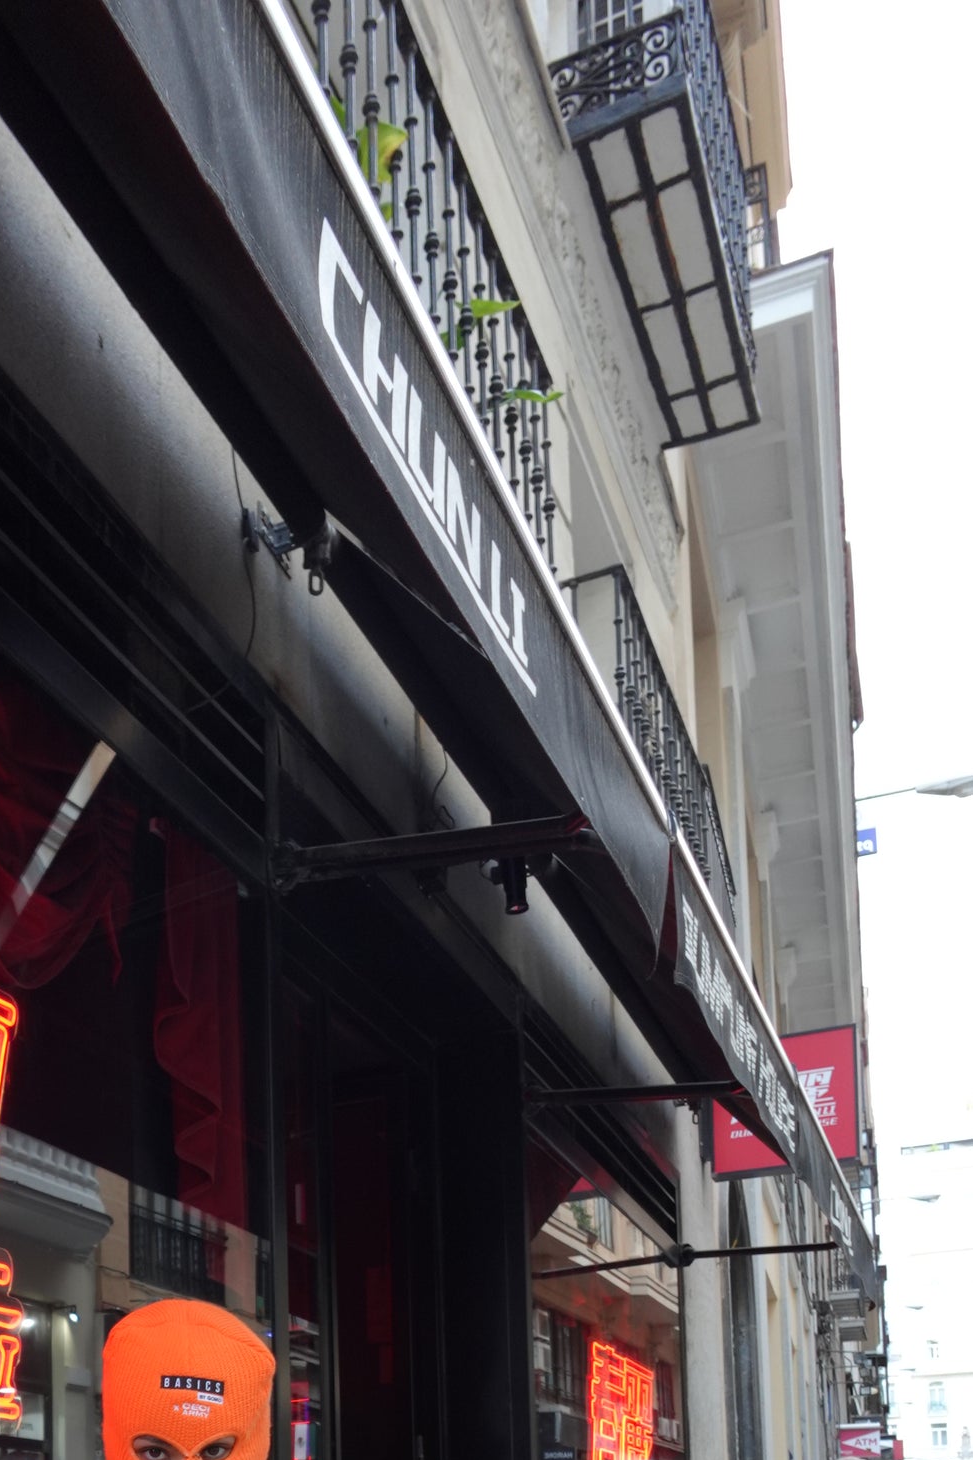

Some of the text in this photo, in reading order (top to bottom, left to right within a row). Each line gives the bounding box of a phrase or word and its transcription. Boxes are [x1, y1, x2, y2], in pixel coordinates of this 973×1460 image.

[317, 216, 484, 592] CHUN
[163, 1377, 221, 1393] BASICS
[182, 1410, 209, 1418] ARMY
[855, 1438, 878, 1446] ATM
